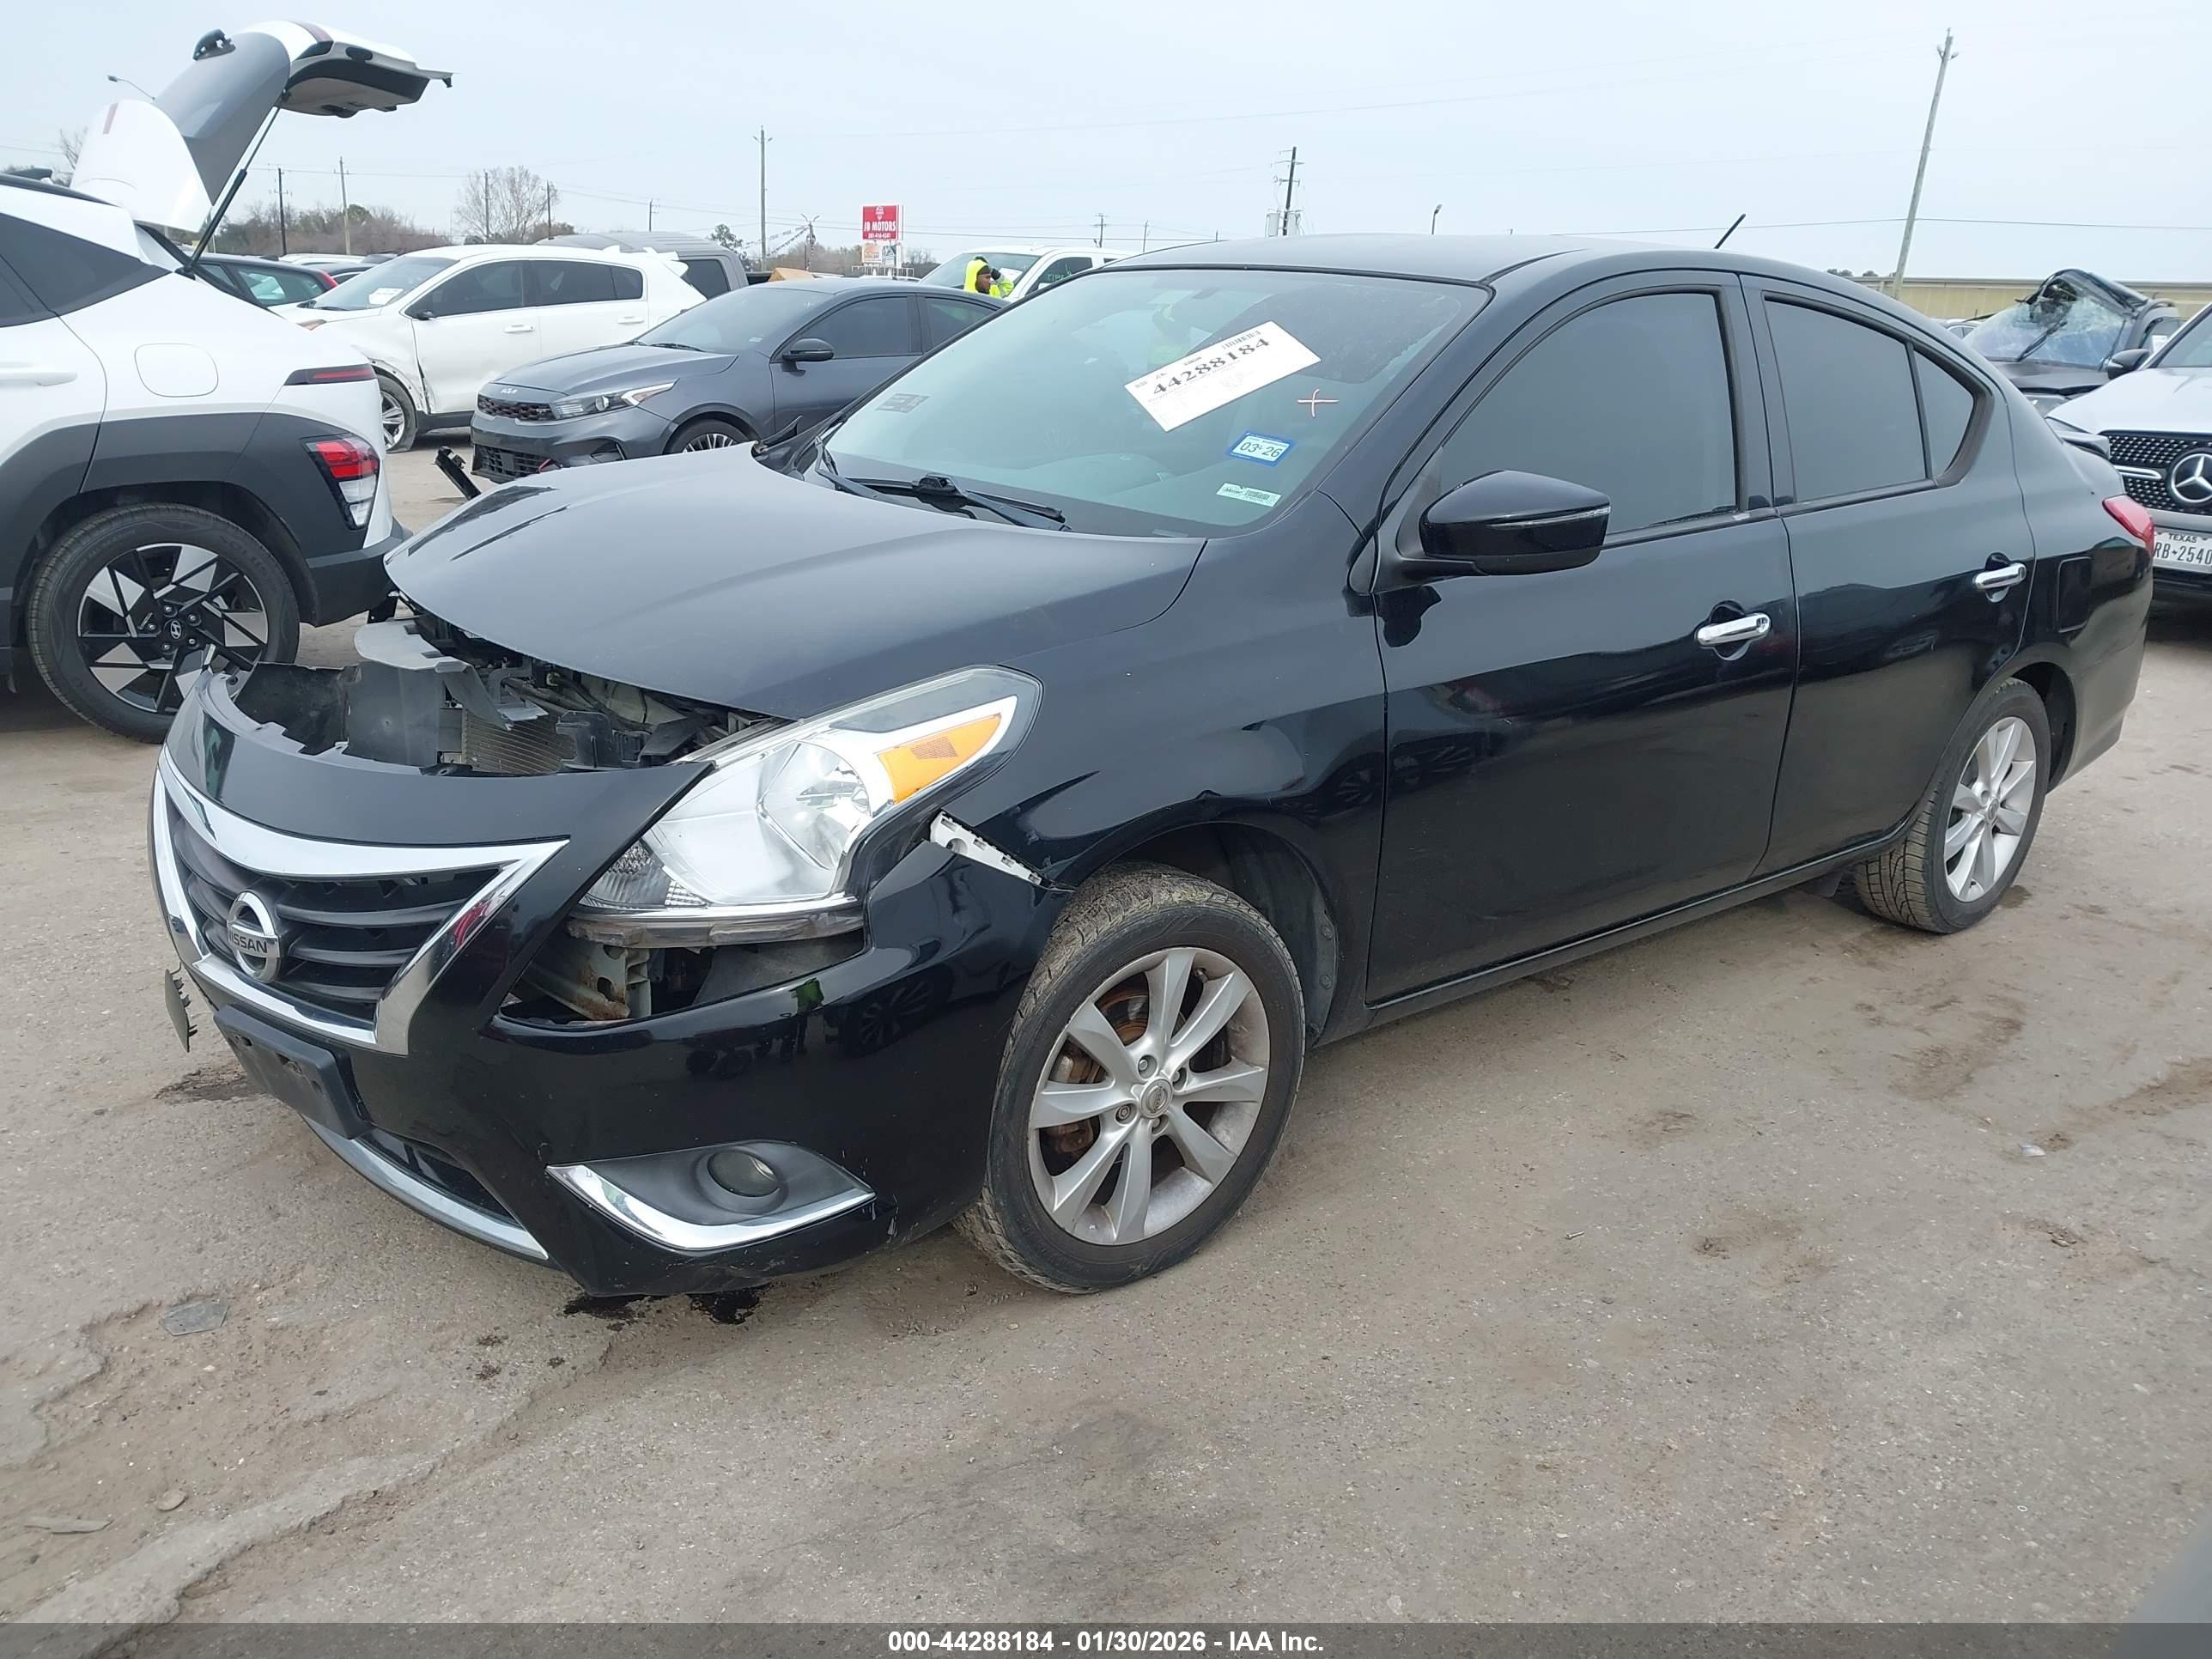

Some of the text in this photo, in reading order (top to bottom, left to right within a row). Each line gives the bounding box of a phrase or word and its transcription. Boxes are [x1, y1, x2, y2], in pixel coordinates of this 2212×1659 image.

[872, 221, 896, 232] MOTORS
[1153, 338, 1270, 394] 44288184
[1261, 447, 1283, 458] 26
[2169, 533, 2197, 543] TEXAS
[228, 928, 268, 954] NISSAN
